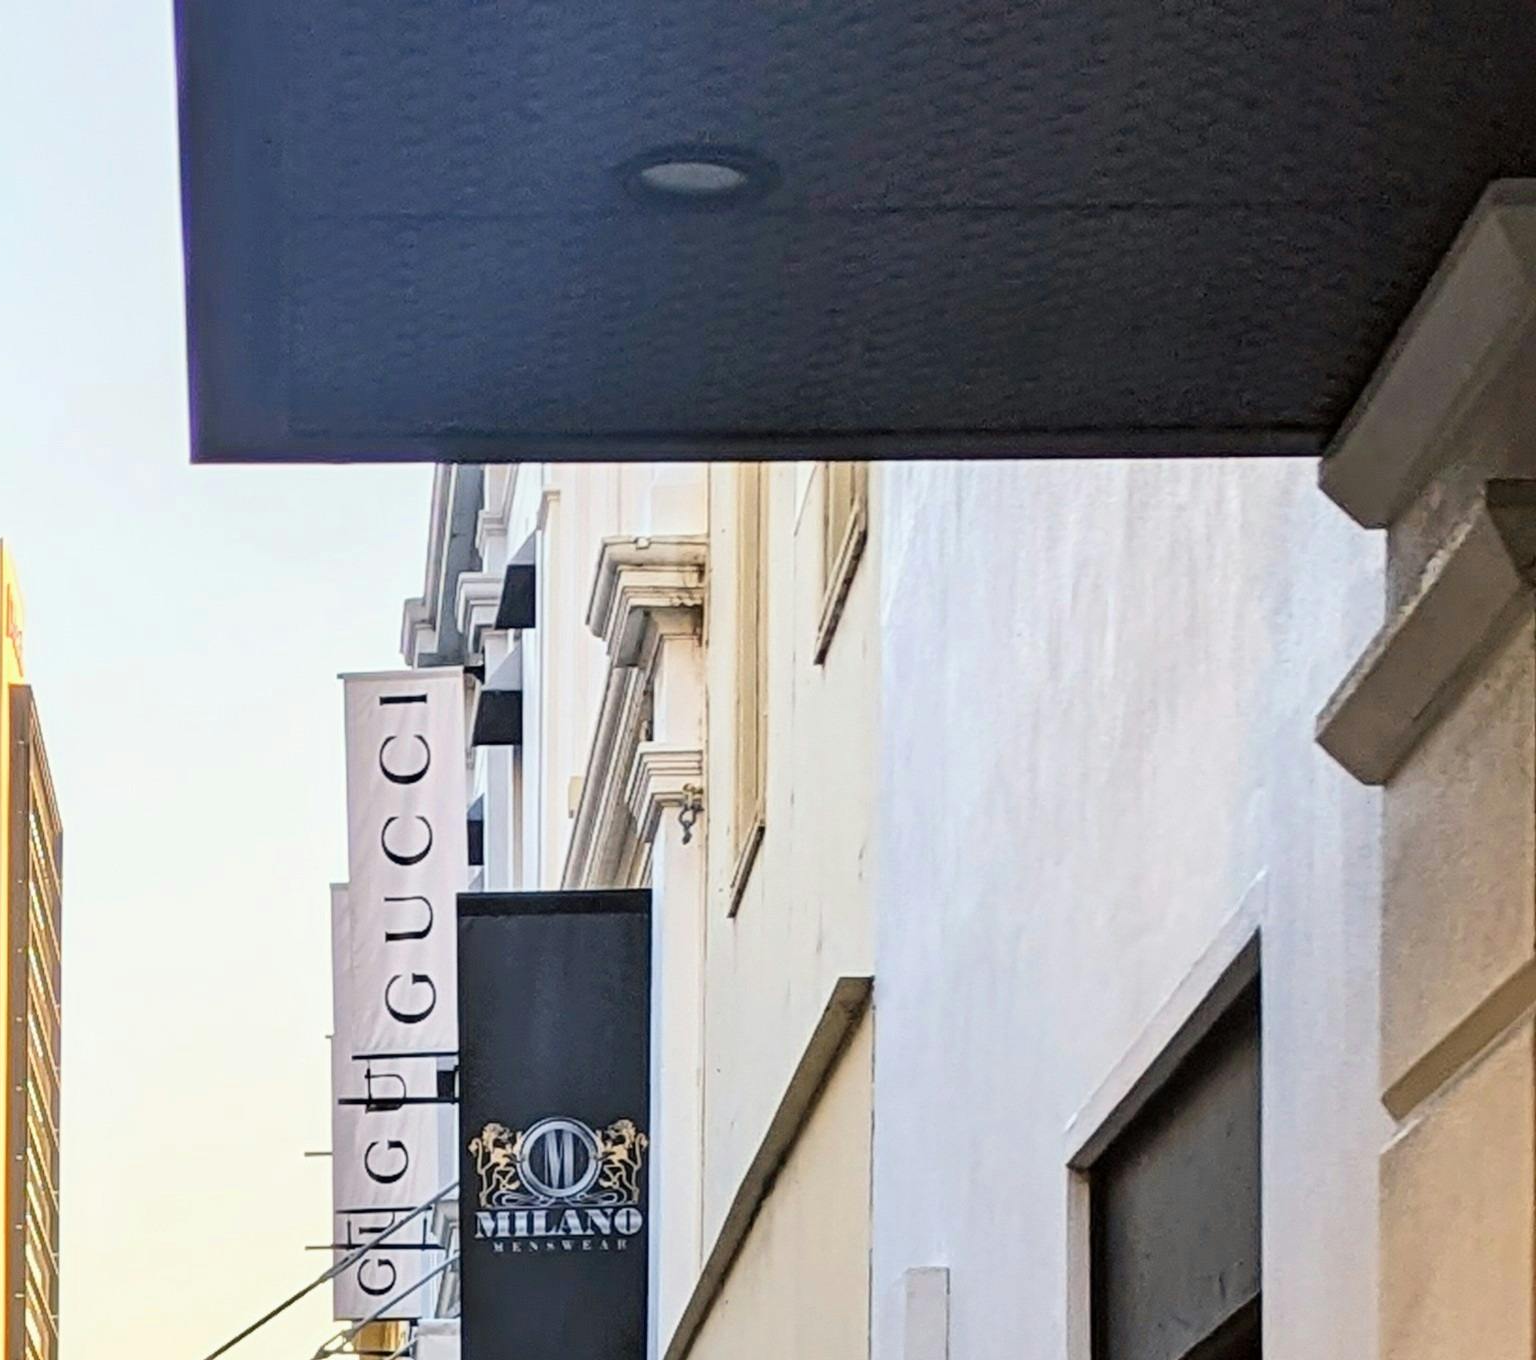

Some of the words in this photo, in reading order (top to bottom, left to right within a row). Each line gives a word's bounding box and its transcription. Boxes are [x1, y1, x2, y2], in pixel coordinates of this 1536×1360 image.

[378, 693, 437, 1024] GUCCI
[474, 1207, 643, 1238] MILANO
[493, 1239, 628, 1253] MENSWEAR
